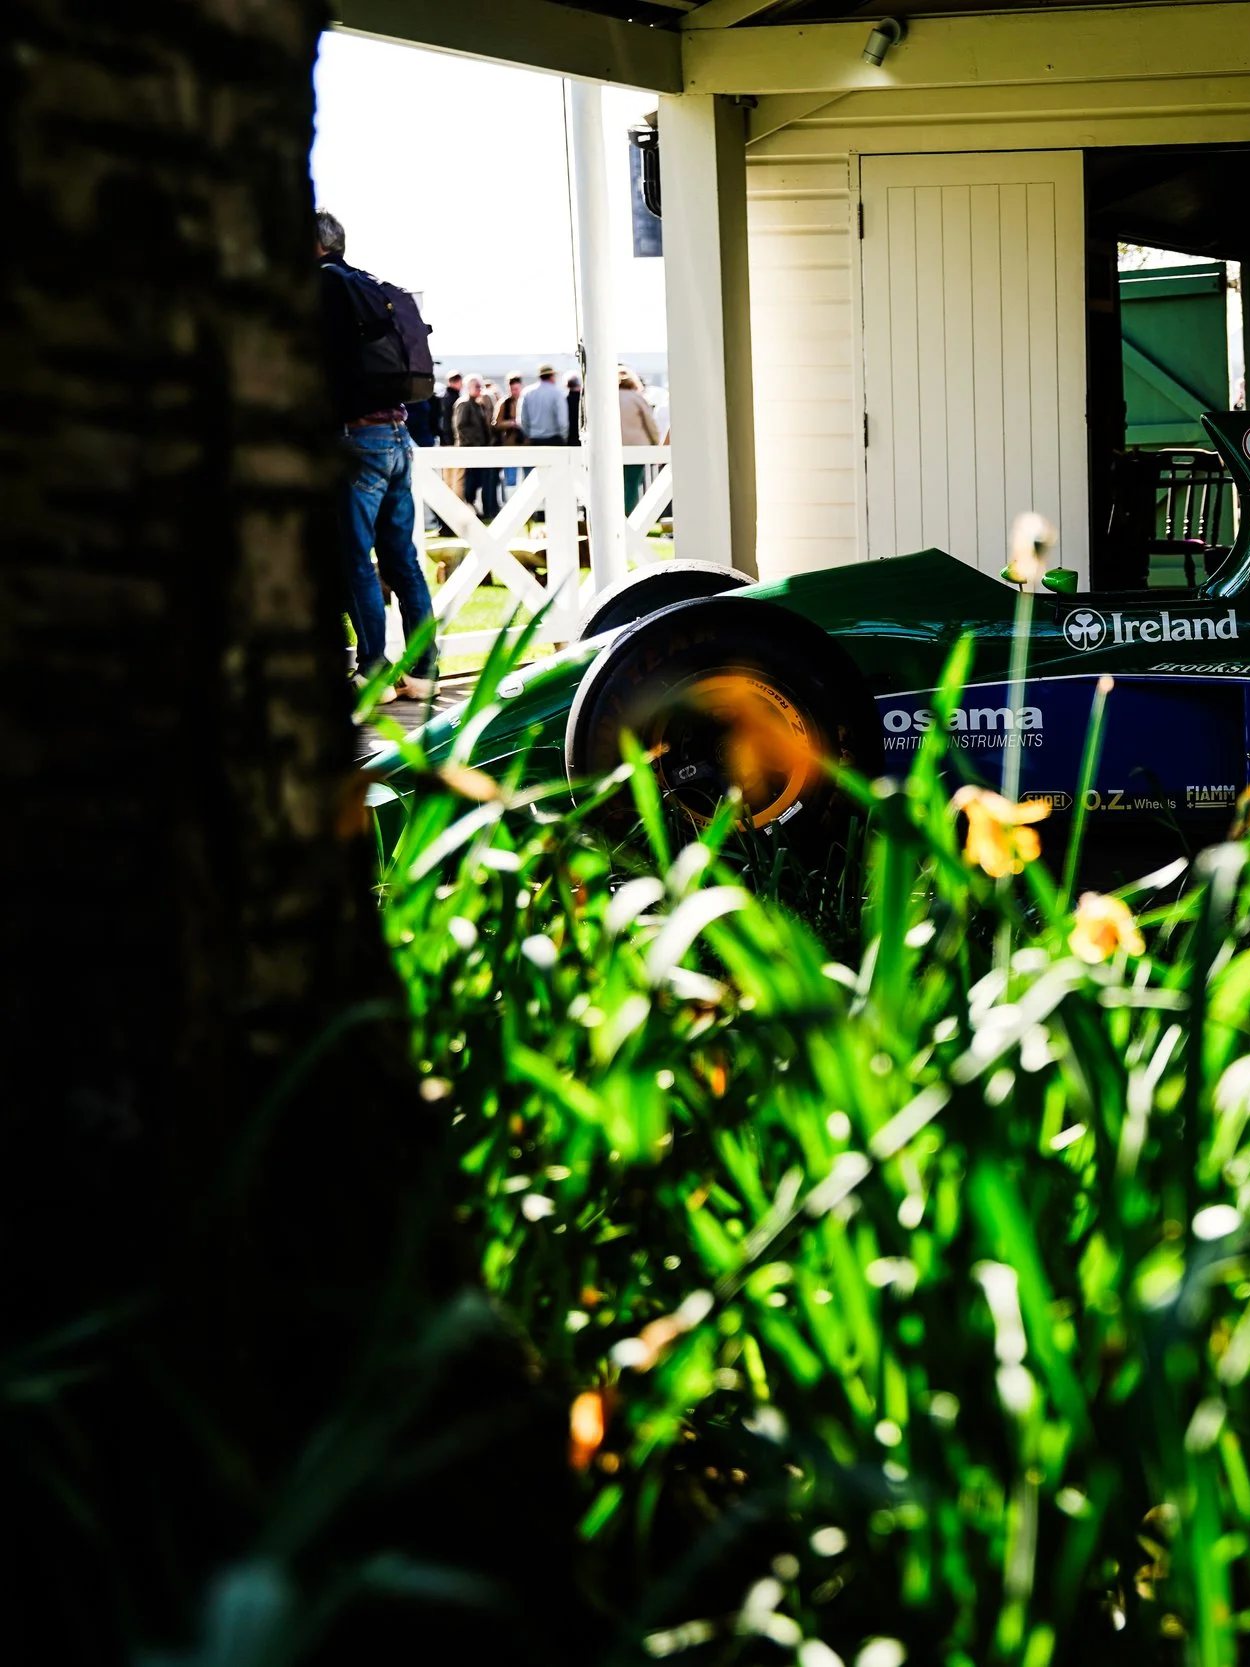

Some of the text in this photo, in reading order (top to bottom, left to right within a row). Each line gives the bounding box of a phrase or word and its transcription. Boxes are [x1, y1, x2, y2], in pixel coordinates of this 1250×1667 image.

[1112, 608, 1240, 644] Ireland
[882, 706, 1044, 733] osama
[883, 733, 1044, 751] WRITIN INSTRUMENTS
